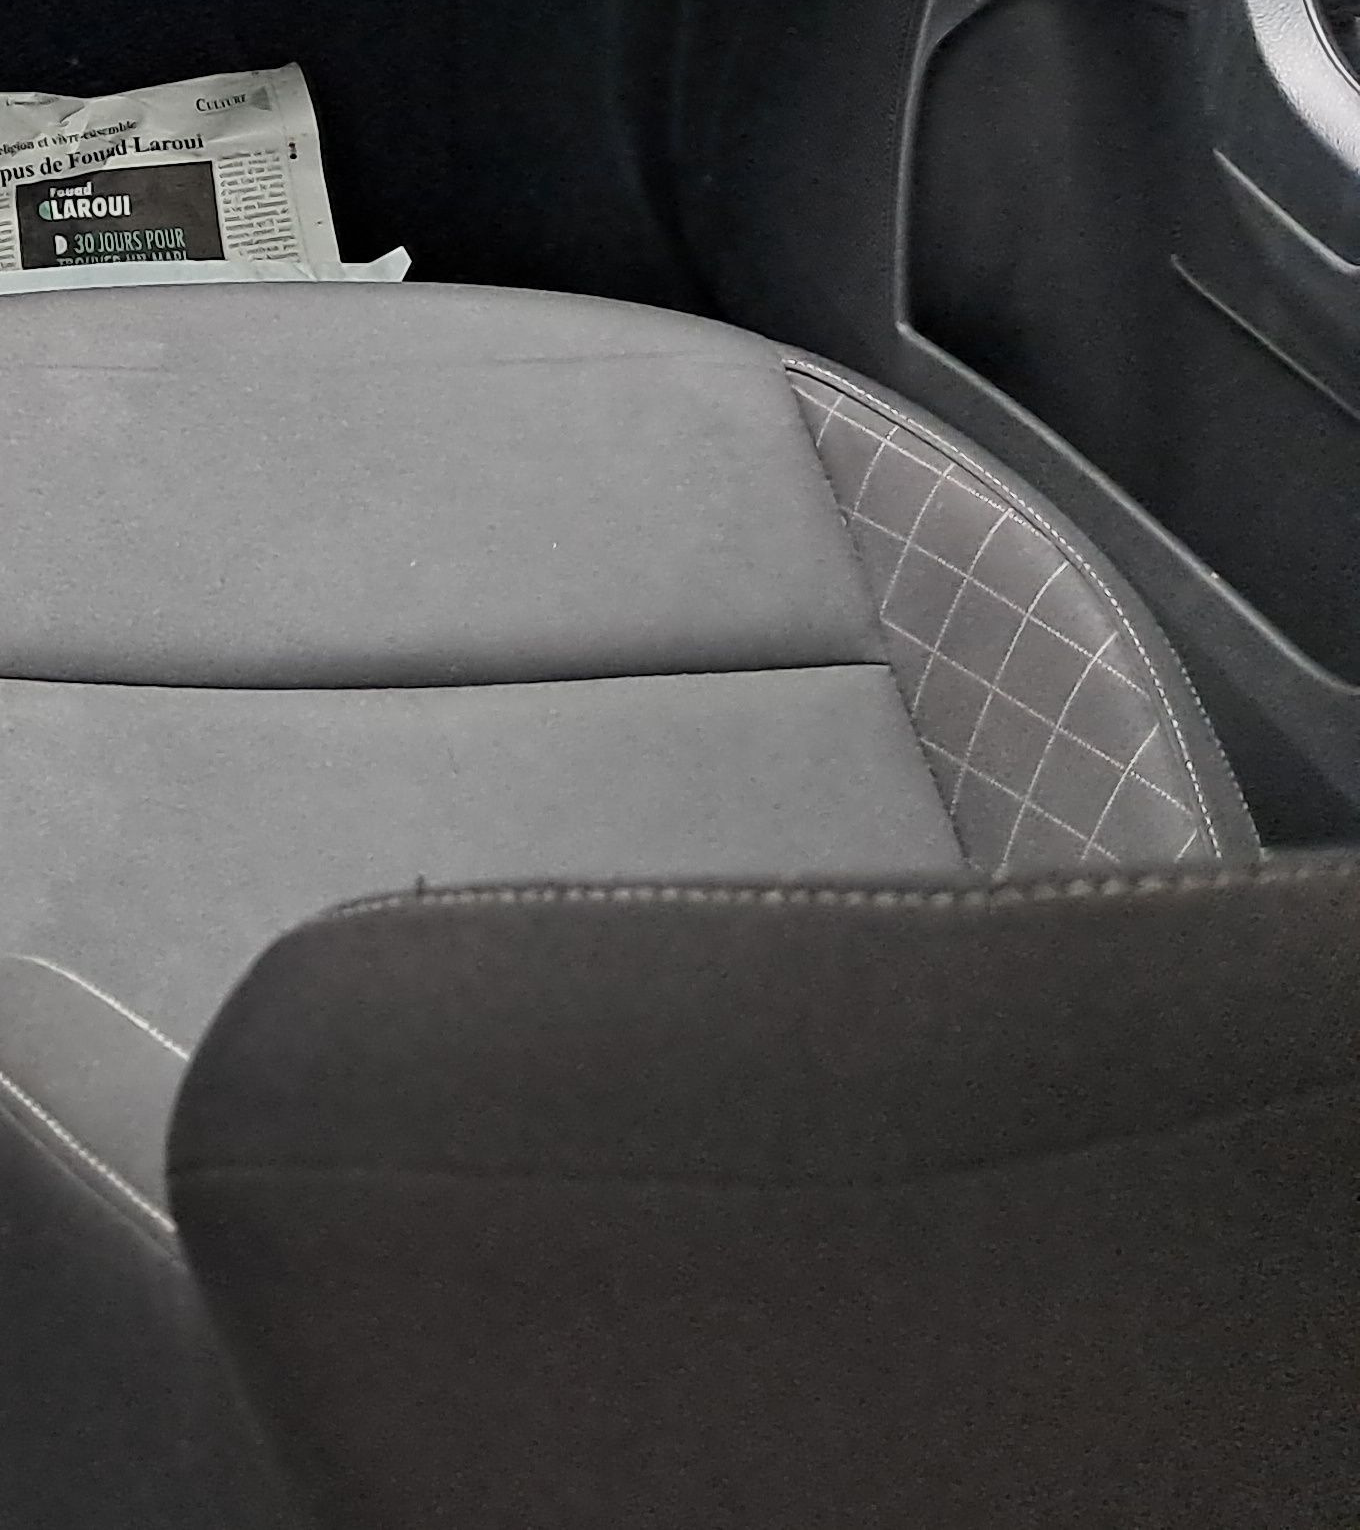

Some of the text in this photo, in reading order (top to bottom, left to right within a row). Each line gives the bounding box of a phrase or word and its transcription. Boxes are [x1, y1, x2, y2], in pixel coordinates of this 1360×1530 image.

[39, 156, 63, 176] de
[67, 139, 128, 169] Fouad
[132, 133, 205, 154] Laroui
[49, 181, 94, 198] Fouad
[50, 194, 132, 221] LAROUI
[73, 226, 186, 254] 30 JOURS POUR
